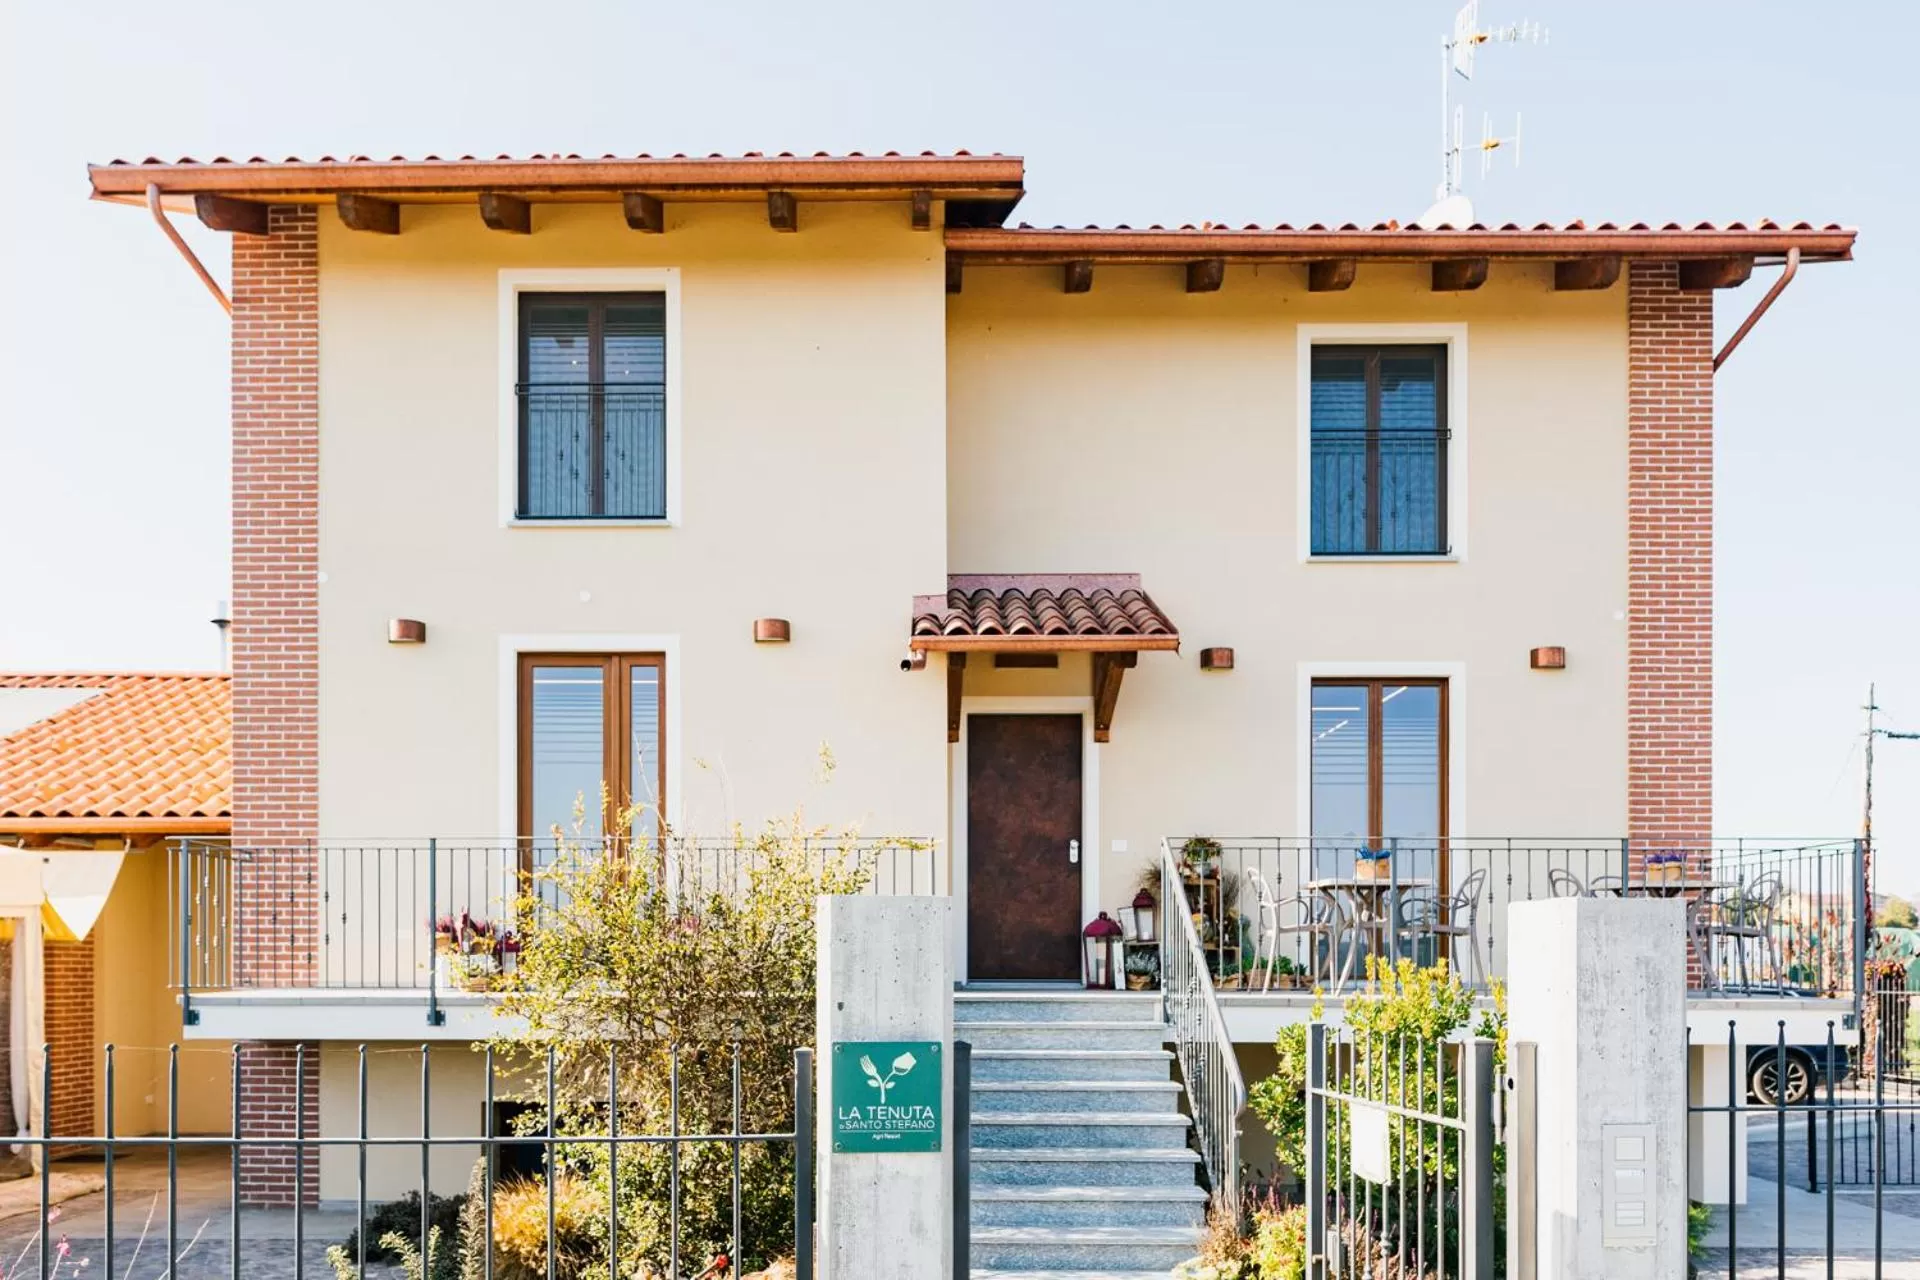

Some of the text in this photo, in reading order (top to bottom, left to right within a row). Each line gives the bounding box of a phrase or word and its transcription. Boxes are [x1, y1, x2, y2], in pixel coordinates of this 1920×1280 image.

[839, 1106, 934, 1120] LA TENUTA
[845, 1120, 883, 1130] SANTO
[884, 1120, 936, 1129] STEFANO
